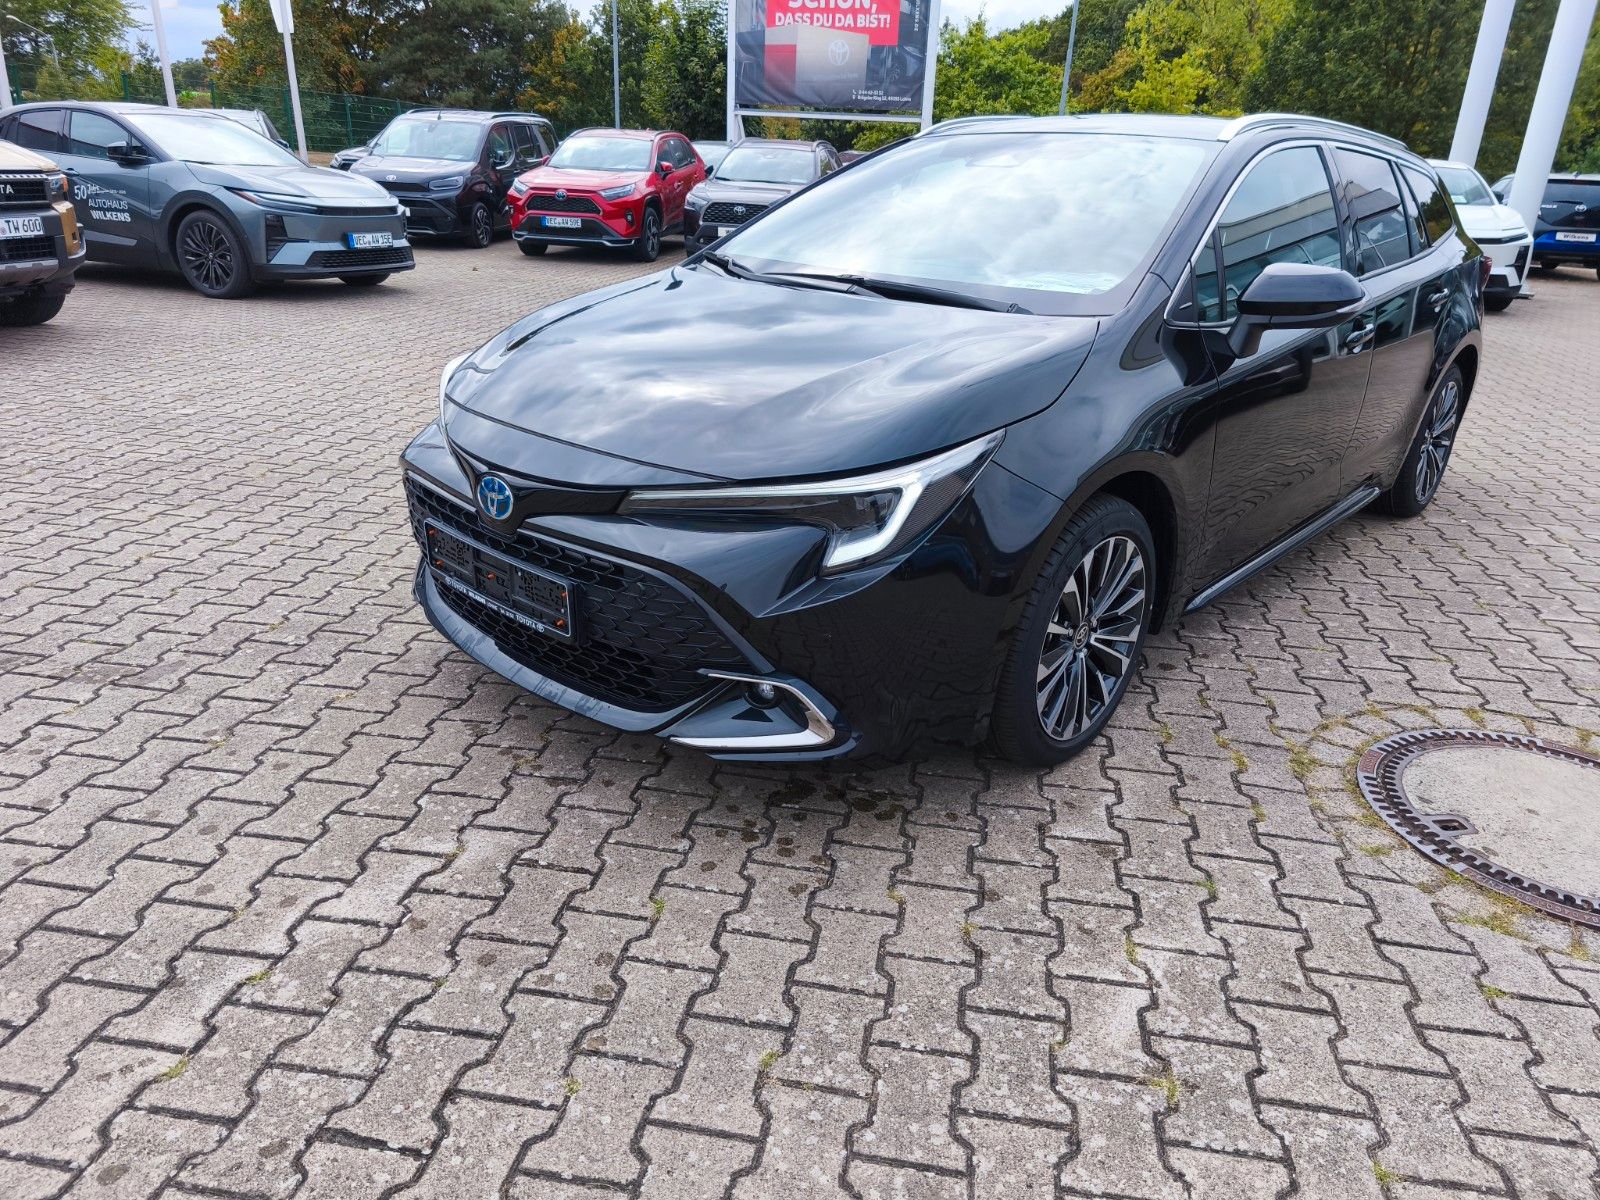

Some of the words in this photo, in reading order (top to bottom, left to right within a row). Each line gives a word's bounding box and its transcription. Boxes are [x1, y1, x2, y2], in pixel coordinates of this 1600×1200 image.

[775, 13, 810, 26] DASS
[813, 13, 832, 26] DU
[835, 14, 854, 27] DA
[857, 14, 890, 28] BIST!
[0, 184, 14, 194] TA
[74, 185, 87, 200] 50
[88, 198, 128, 210] AUTOHAUS
[90, 210, 131, 222] WILKENS
[22, 218, 42, 233] 600
[354, 235, 367, 246] VEC
[516, 614, 536, 629] TOYOTA
